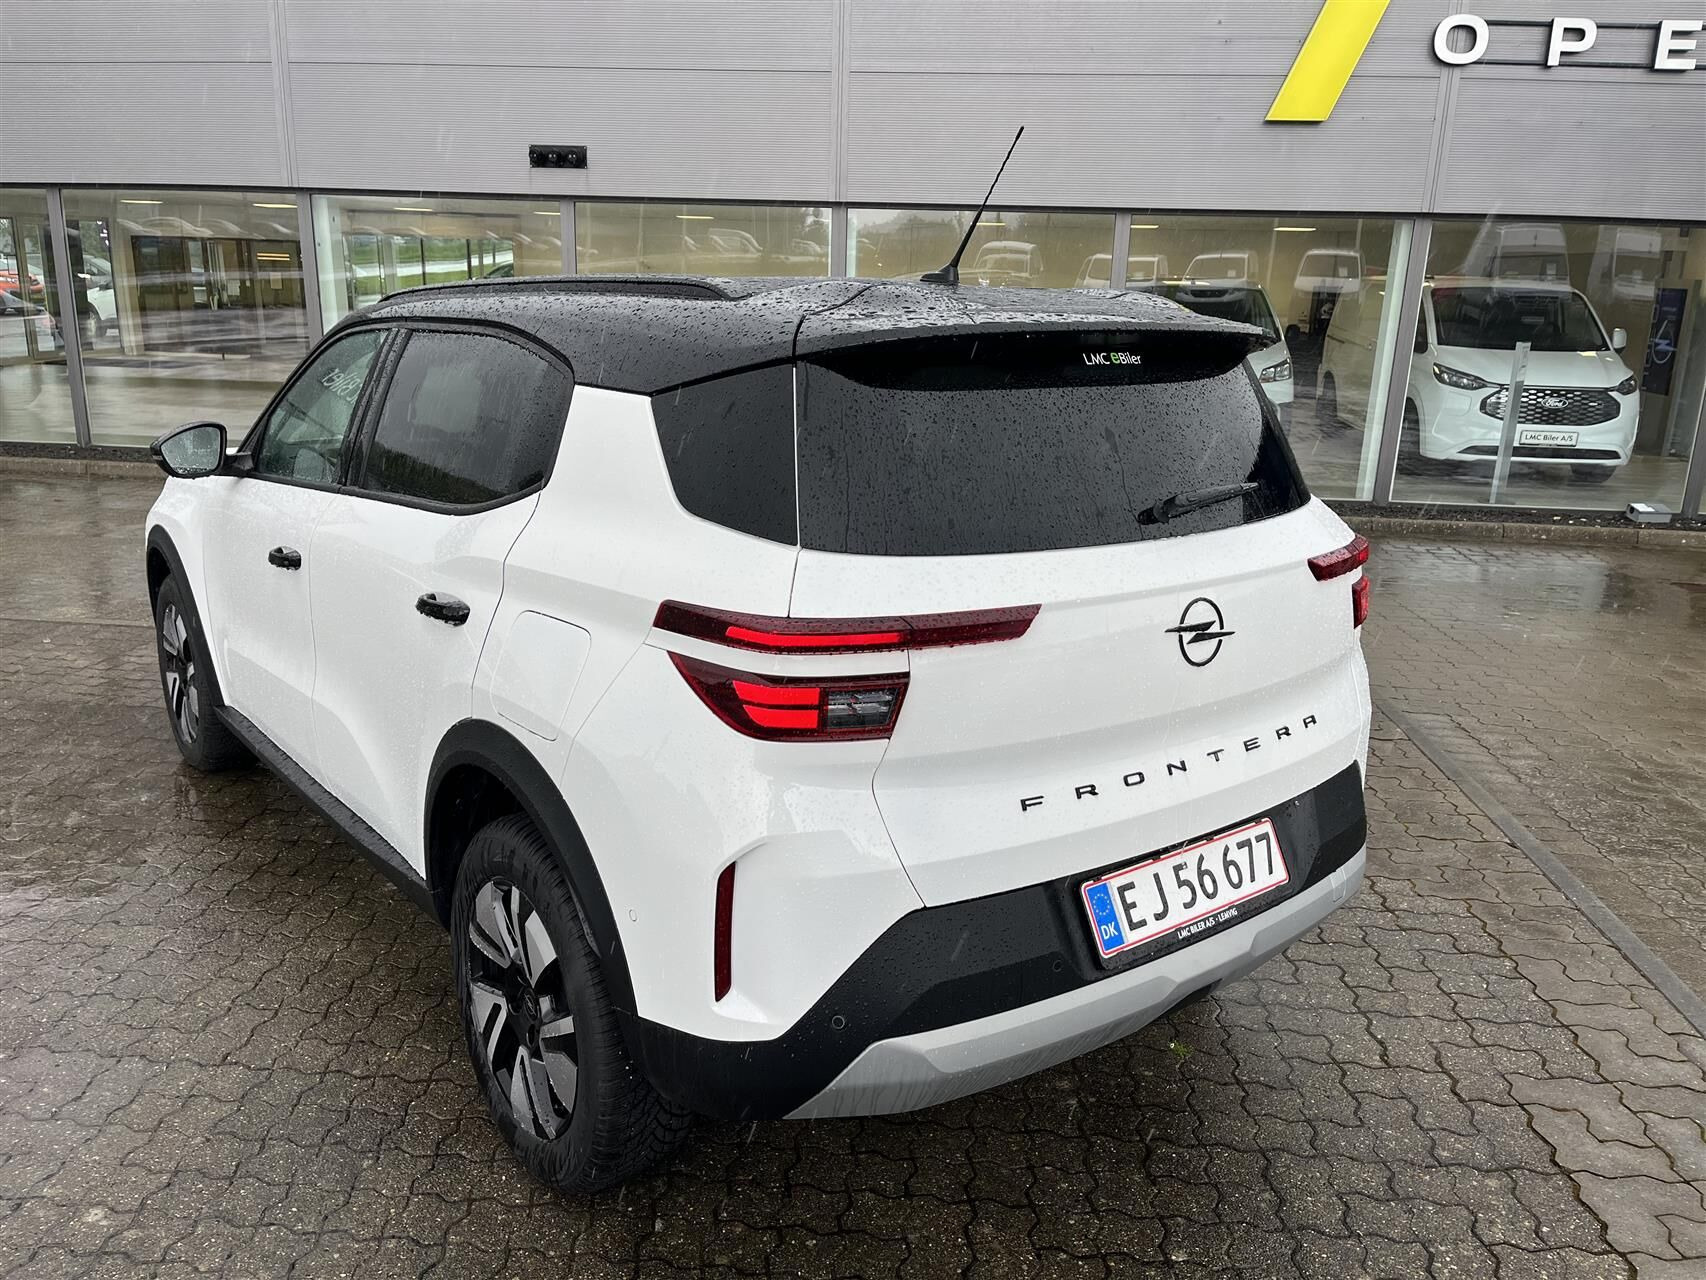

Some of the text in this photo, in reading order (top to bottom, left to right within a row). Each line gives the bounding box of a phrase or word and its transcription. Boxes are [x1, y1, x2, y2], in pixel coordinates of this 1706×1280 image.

[1082, 351, 1141, 366] LMC eBiler
[1544, 398, 1565, 408] Ford
[1525, 433, 1541, 441] LMC
[1020, 714, 1318, 812] FRONTERA
[1116, 831, 1274, 931] EJ 56 677
[1101, 922, 1119, 940] DK
[1177, 927, 1191, 939] LMC
[1190, 922, 1206, 934] BILER
[1205, 917, 1215, 928] A/S
